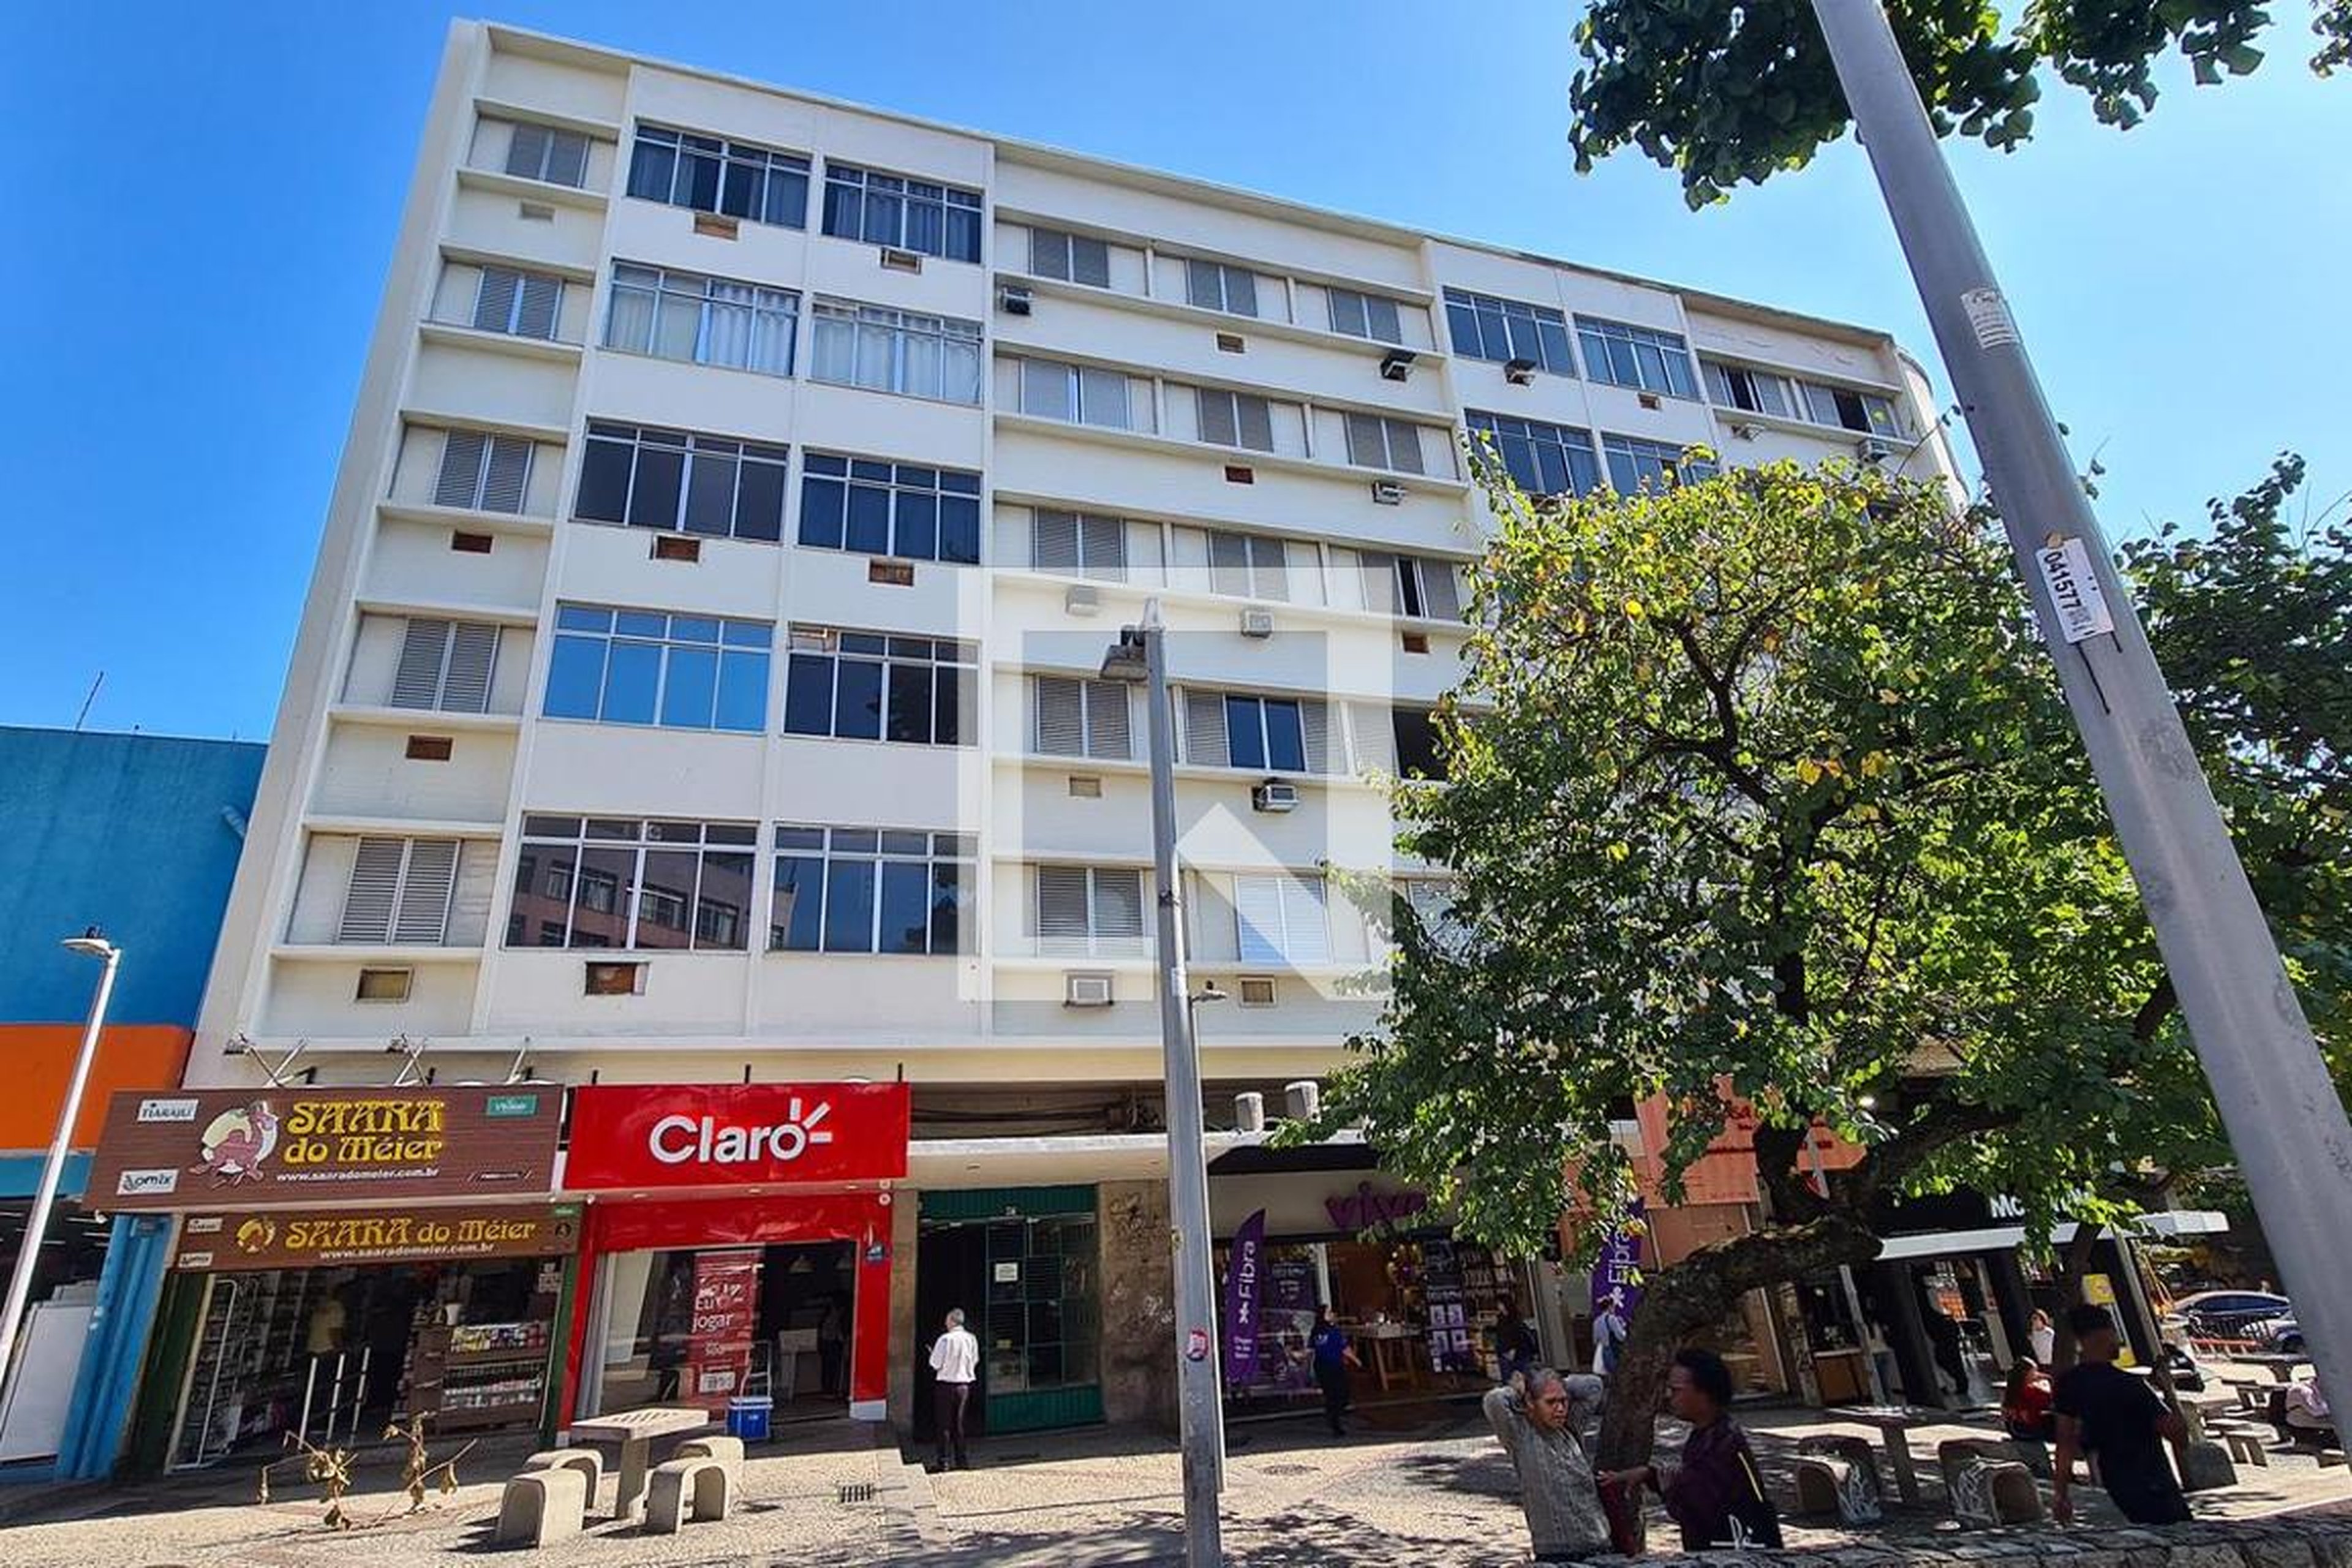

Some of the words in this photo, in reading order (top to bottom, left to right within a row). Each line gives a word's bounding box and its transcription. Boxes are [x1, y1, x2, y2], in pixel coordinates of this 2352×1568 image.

[2043, 551, 2082, 609] 041577
[287, 1101, 445, 1134] SAARA
[649, 1113, 807, 1163] Claro
[284, 1137, 328, 1163] do
[337, 1136, 442, 1162] Méier
[284, 1218, 413, 1248] SAARA
[417, 1223, 451, 1243] do
[1237, 1240, 1256, 1299] Fibra
